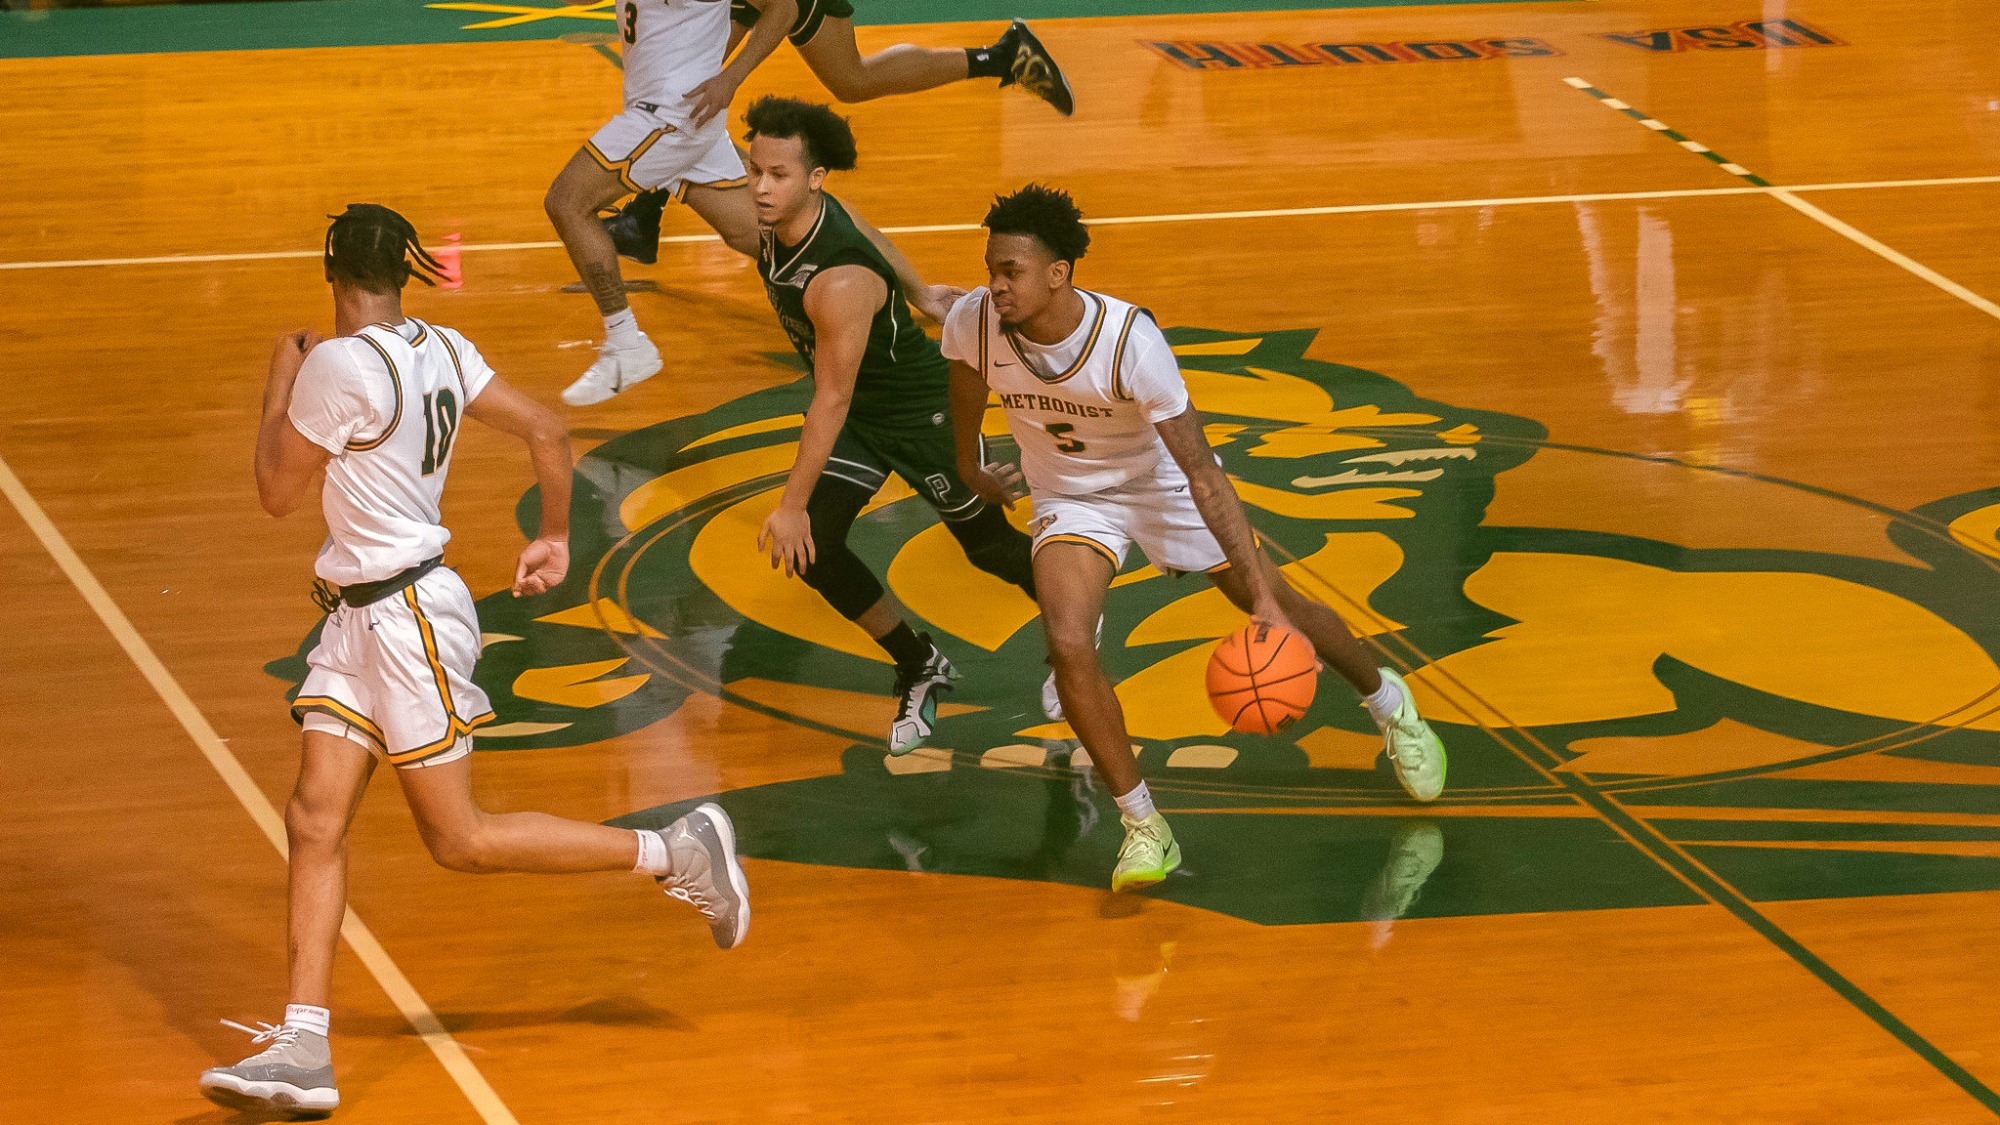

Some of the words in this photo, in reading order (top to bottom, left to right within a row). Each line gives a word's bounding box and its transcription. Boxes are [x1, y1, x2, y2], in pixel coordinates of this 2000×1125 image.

[624, 2, 638, 45] 3
[1600, 18, 1844, 52] USA
[1141, 38, 1560, 70] SOUTH
[1000, 394, 1113, 418] METHODIST
[421, 387, 457, 478] 10
[1045, 422, 1087, 453] 5
[924, 472, 952, 504] P
